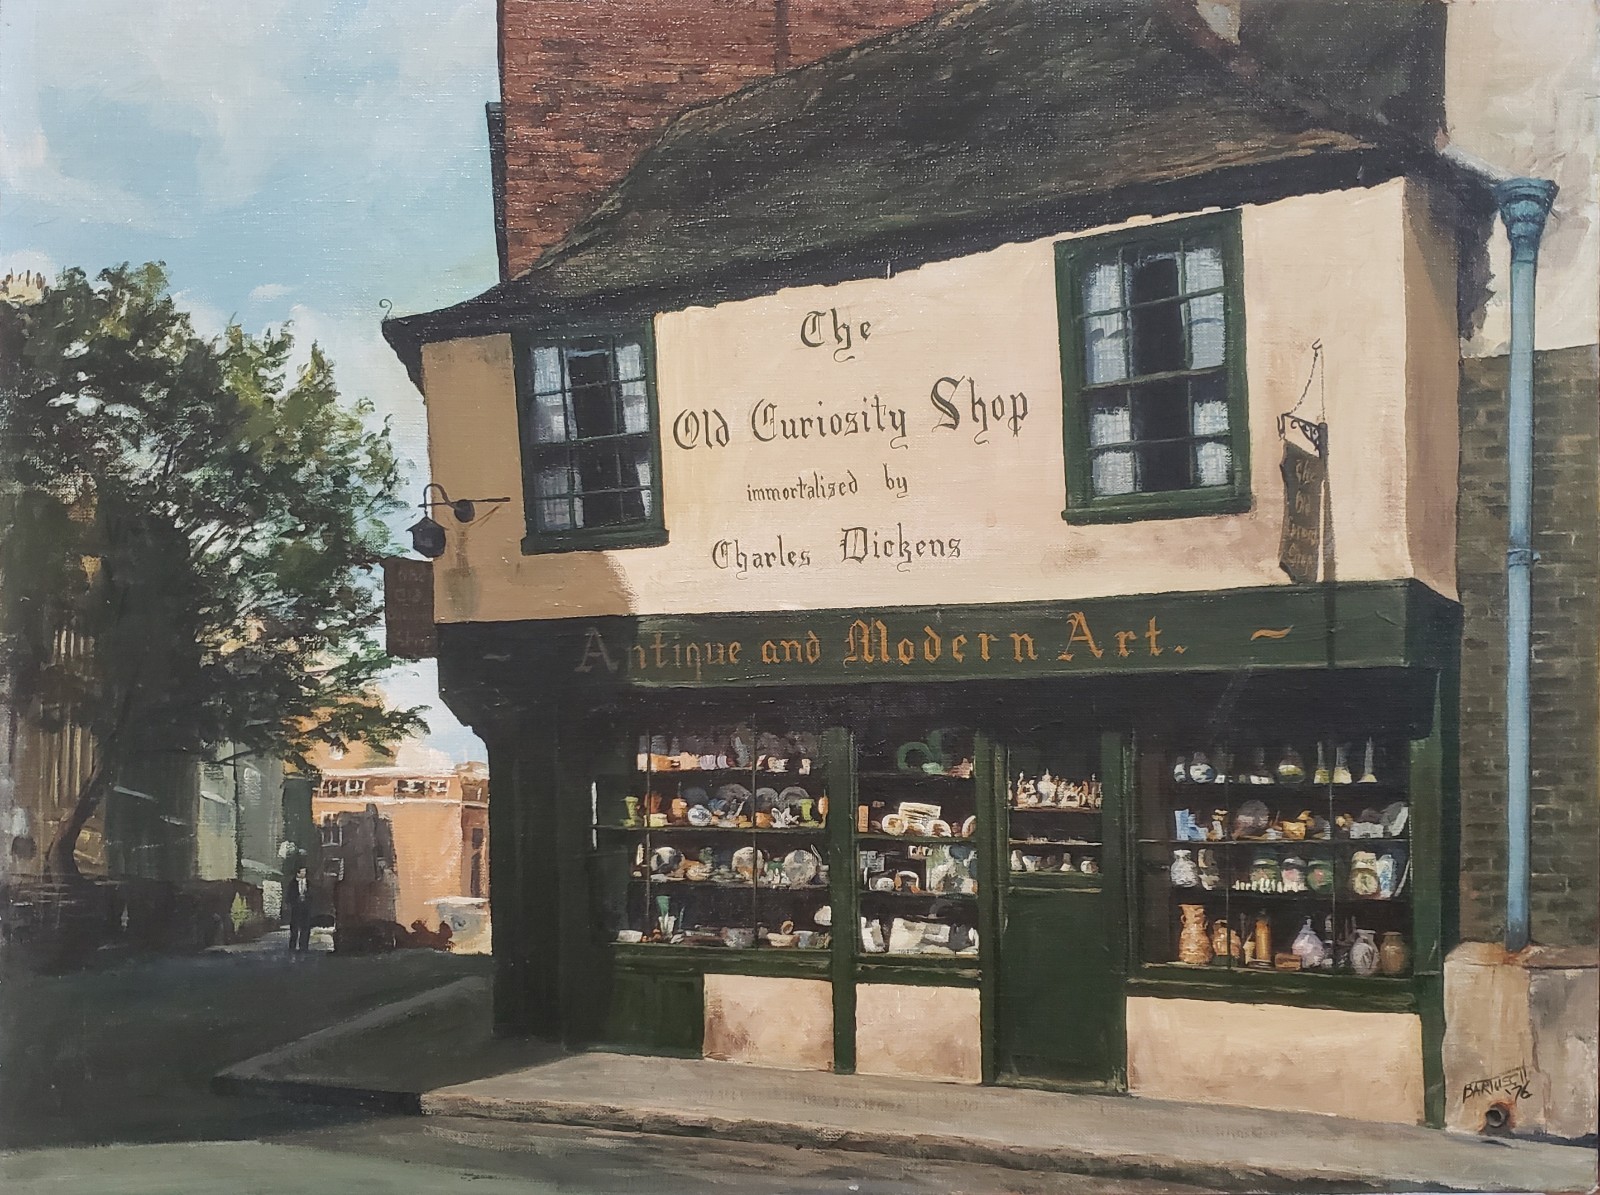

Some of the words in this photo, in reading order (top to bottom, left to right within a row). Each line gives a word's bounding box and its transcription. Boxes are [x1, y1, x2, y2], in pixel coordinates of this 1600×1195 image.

[801, 307, 872, 362] The
[673, 408, 730, 450] Old
[752, 395, 909, 450] Curiosity
[930, 376, 1029, 445] Shop
[747, 469, 858, 502] immortalised
[882, 463, 908, 498] by
[712, 535, 811, 580] Charles
[839, 522, 962, 572] Dickens
[574, 627, 742, 680] Antique
[761, 630, 821, 665] and
[843, 618, 1038, 668] Modern
[1058, 611, 1188, 661] Art.
